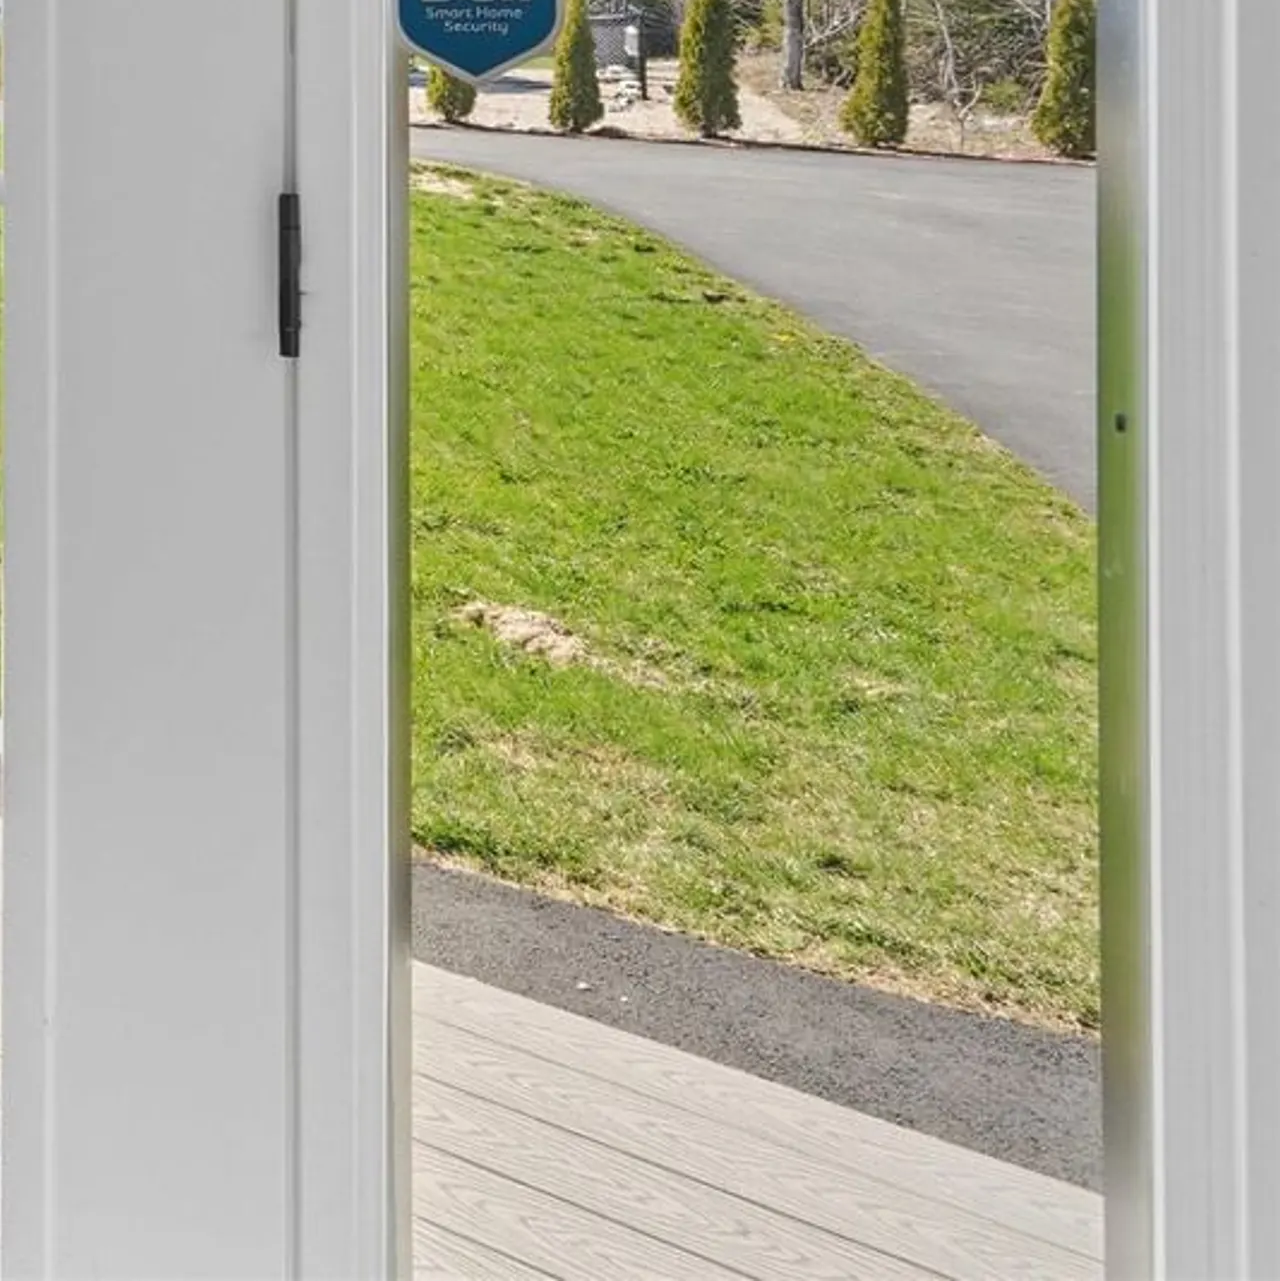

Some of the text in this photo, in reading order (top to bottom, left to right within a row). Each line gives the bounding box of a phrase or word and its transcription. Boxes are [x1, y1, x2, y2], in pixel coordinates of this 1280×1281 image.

[426, 6, 523, 20] Smart Home
[444, 21, 509, 35] Security
